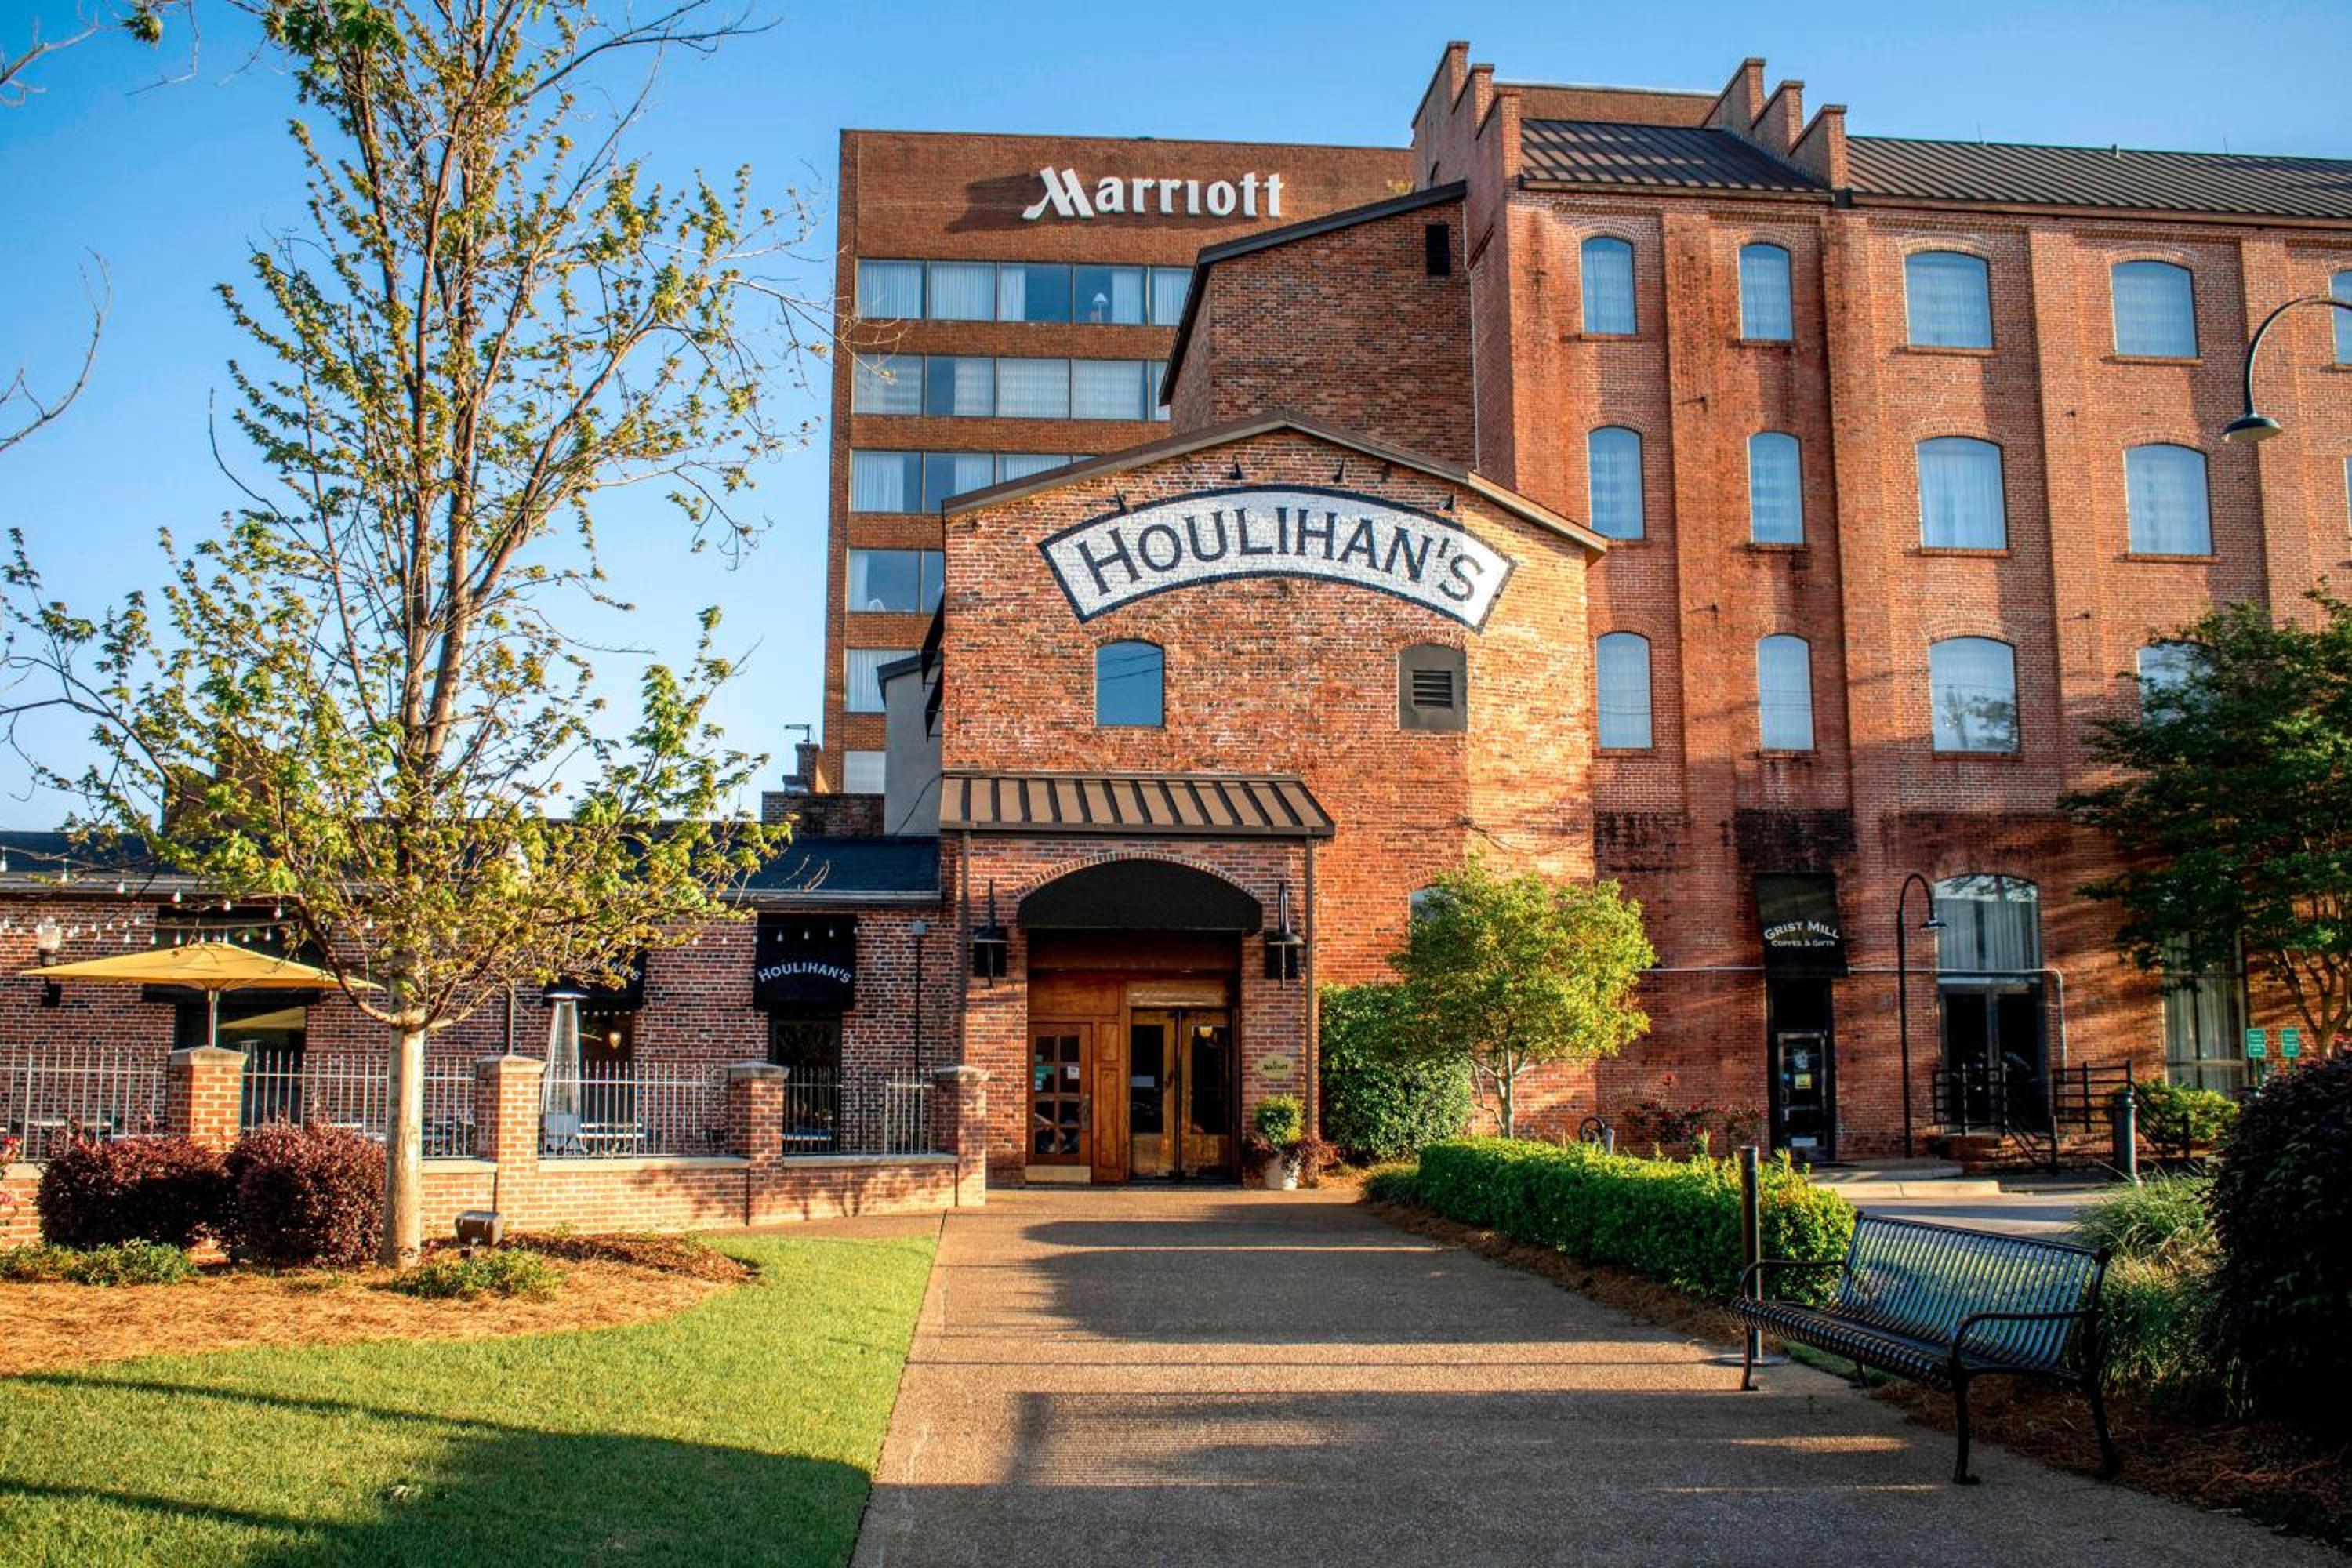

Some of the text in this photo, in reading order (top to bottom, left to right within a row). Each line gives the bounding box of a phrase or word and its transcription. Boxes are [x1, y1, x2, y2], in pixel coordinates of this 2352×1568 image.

[1022, 166, 1284, 220] Marriott
[1073, 506, 1484, 603] HOULIHAN'S
[1763, 920, 1839, 940] GRIST MILL
[757, 961, 851, 983] HOULIHAN'S
